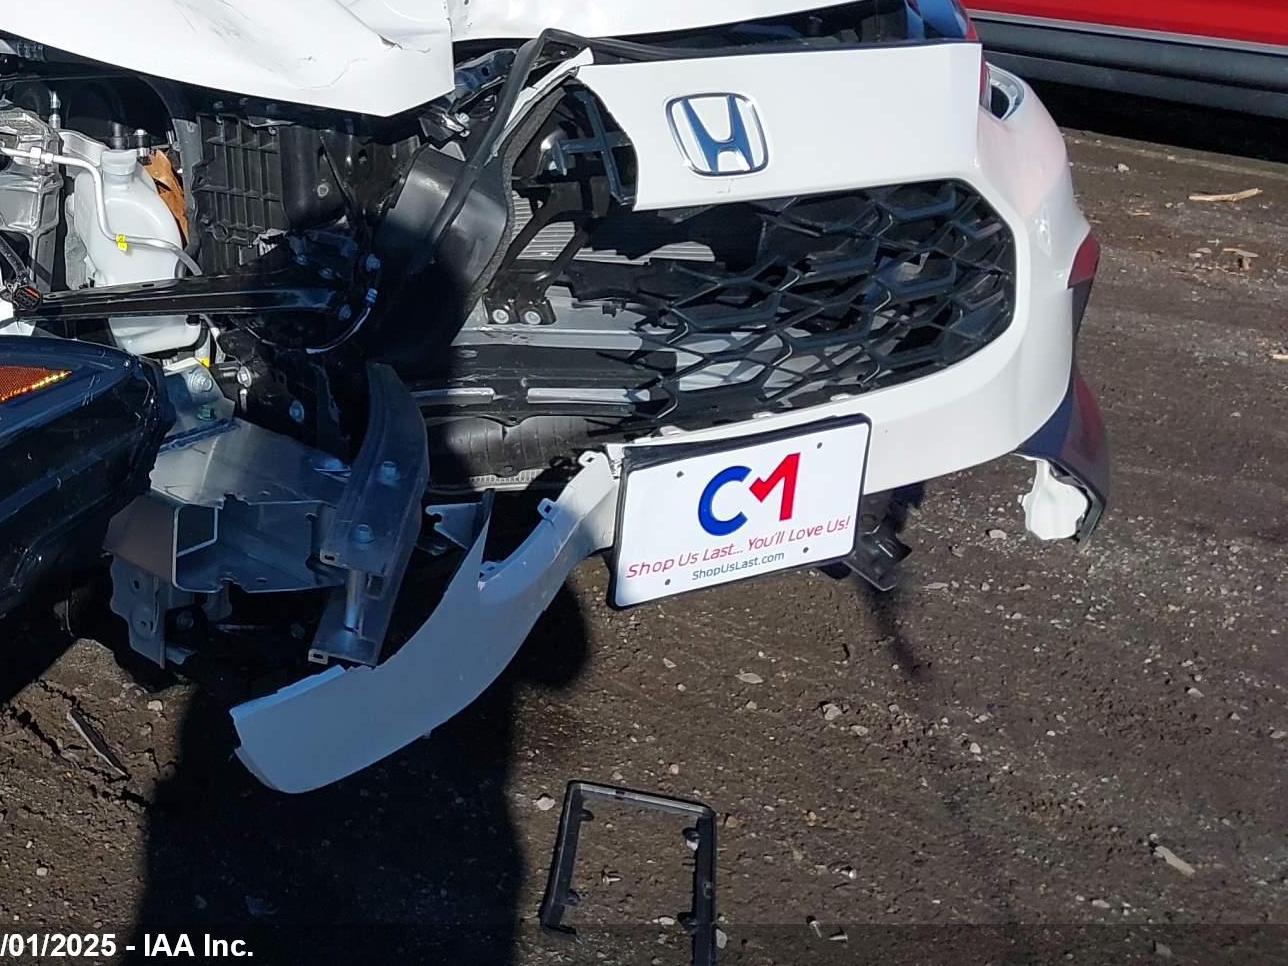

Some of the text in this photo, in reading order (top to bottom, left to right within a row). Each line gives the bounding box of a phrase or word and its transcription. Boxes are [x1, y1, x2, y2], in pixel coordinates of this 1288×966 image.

[626, 515, 851, 579] Shop Us Last... You'll Love Us!
[691, 551, 785, 581] ShopUsLast.com
